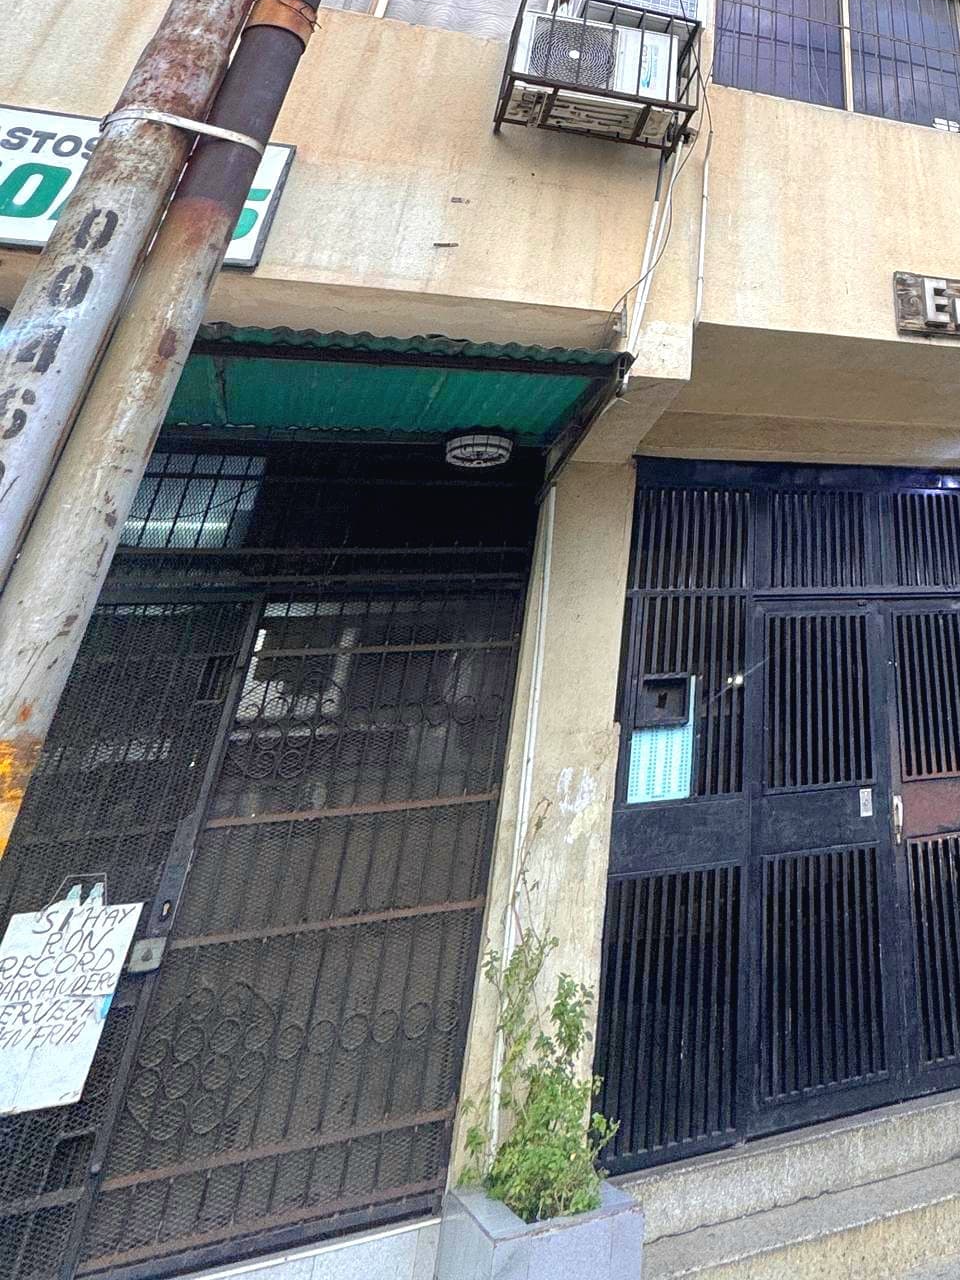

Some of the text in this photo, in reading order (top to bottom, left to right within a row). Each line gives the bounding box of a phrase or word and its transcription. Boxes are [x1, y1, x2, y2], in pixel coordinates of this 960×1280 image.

[0, 126, 100, 161] STOS
[80, 905, 137, 930] HAY
[40, 927, 115, 956] RON
[0, 948, 115, 980] RECORD
